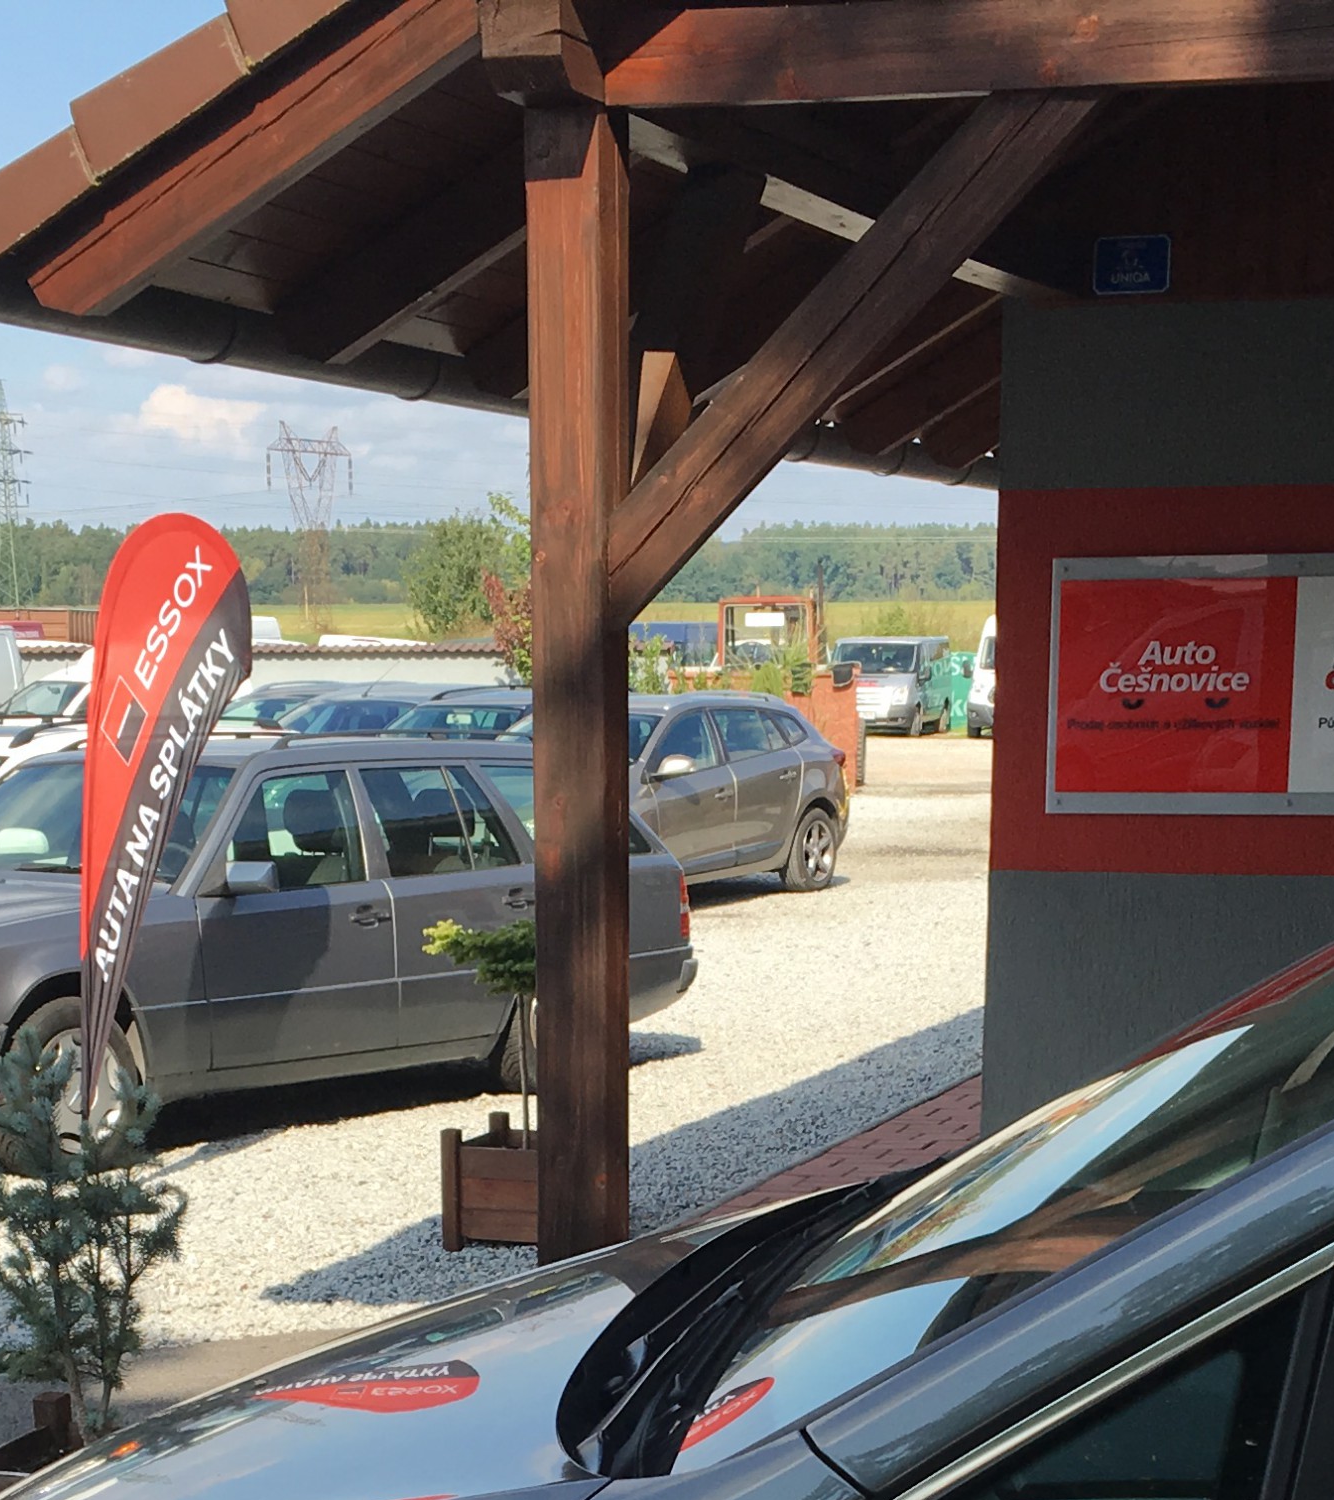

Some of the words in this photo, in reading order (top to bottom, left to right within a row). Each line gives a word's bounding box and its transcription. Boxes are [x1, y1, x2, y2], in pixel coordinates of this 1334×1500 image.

[1110, 272, 1152, 284] UNIQA
[134, 545, 213, 690] ESSOX
[1137, 640, 1216, 665] Auto
[1099, 662, 1250, 693] Češnovice
[95, 868, 140, 983] AUTA
[125, 804, 160, 867] NA
[149, 628, 235, 800] SPLÁTKY
